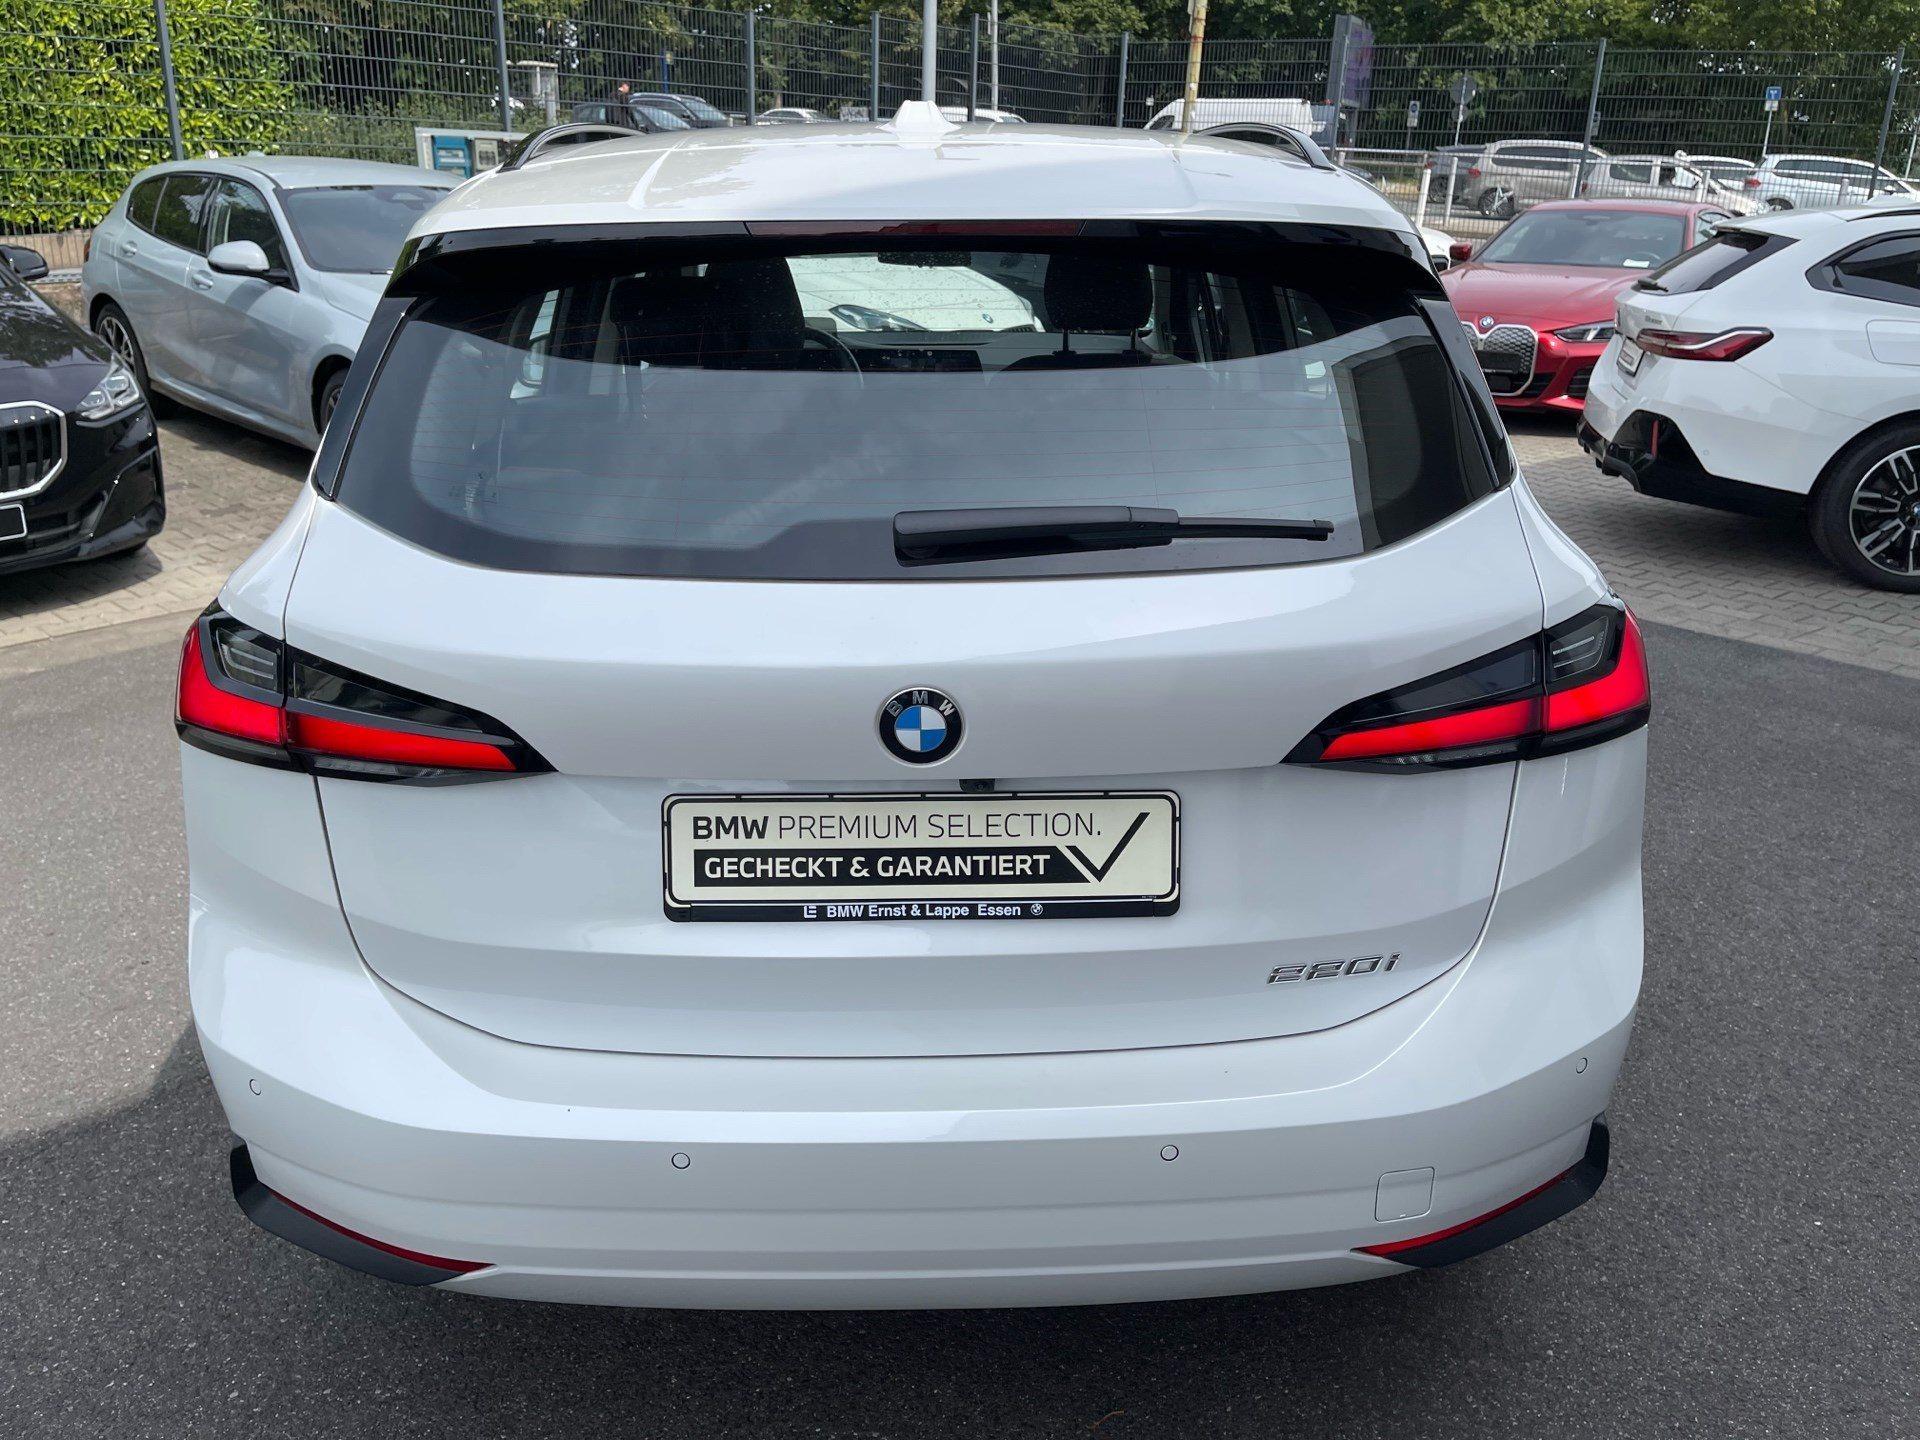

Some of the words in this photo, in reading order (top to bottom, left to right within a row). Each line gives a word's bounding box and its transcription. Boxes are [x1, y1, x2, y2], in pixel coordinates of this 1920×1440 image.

[886, 690, 956, 717] BMW
[692, 815, 769, 840] BMW
[778, 814, 917, 839] PREMIUM
[928, 812, 1101, 838] SELECTION.
[704, 856, 844, 879] GECHECKT
[849, 856, 871, 878] &
[877, 854, 1051, 878] GARANTIERT
[826, 904, 864, 918] BMW
[868, 904, 907, 917] Ernst
[910, 903, 922, 917] &
[925, 903, 970, 919] Lappe
[977, 903, 1021, 916] Essen
[1267, 952, 1401, 985] 220i
